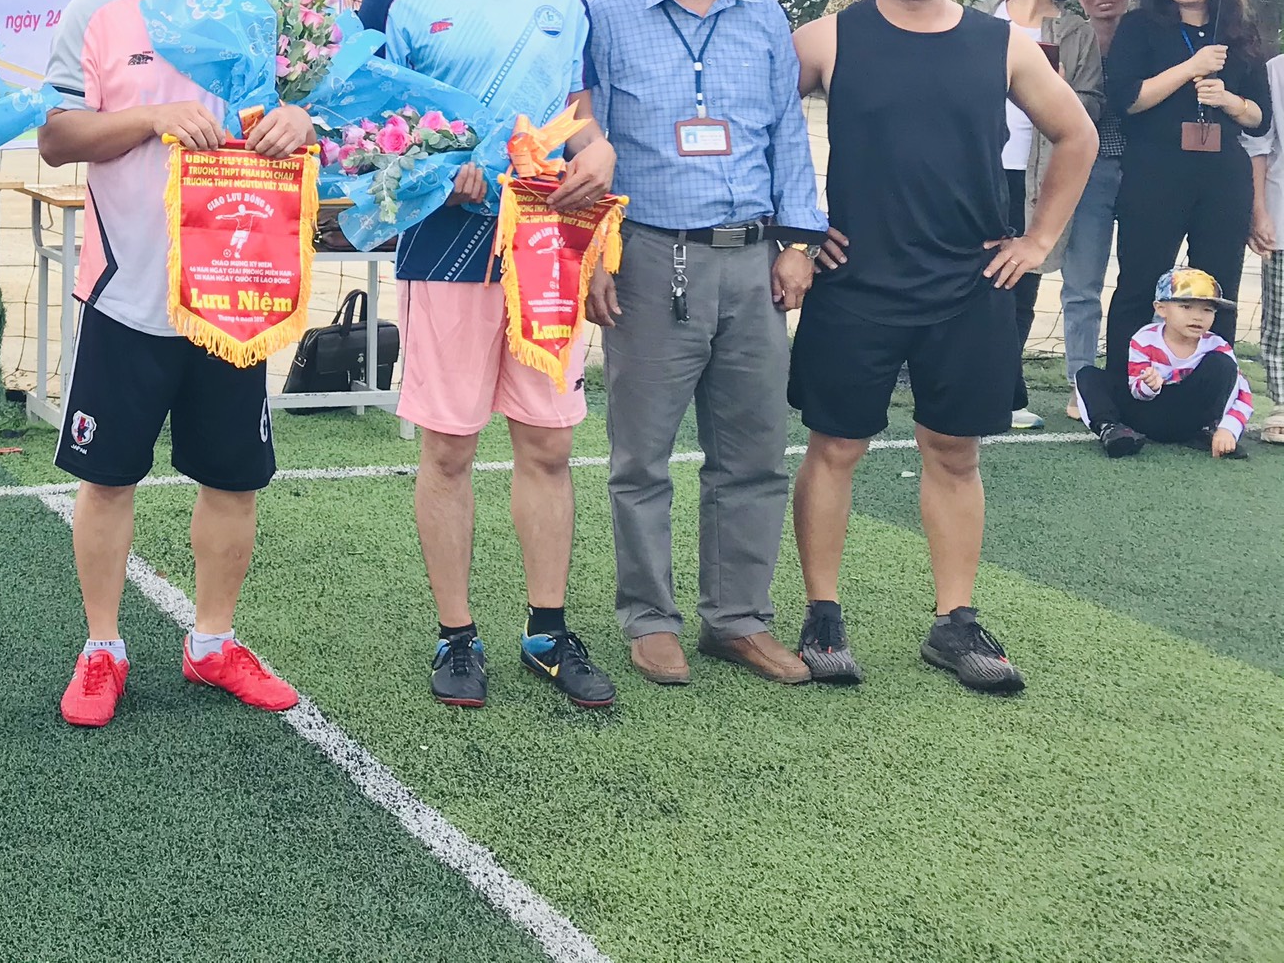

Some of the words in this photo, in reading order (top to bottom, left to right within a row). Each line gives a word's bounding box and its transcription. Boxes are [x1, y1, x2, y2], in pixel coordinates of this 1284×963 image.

[6, 10, 41, 33] ngày
[185, 155, 215, 164] UBND
[272, 161, 300, 170] LINH
[221, 167, 239, 176] THPT
[241, 168, 261, 178] PHAN
[214, 178, 233, 187] THPT
[207, 196, 225, 211] GIAO
[190, 288, 231, 310] Lưu
[238, 290, 293, 316] Niệm
